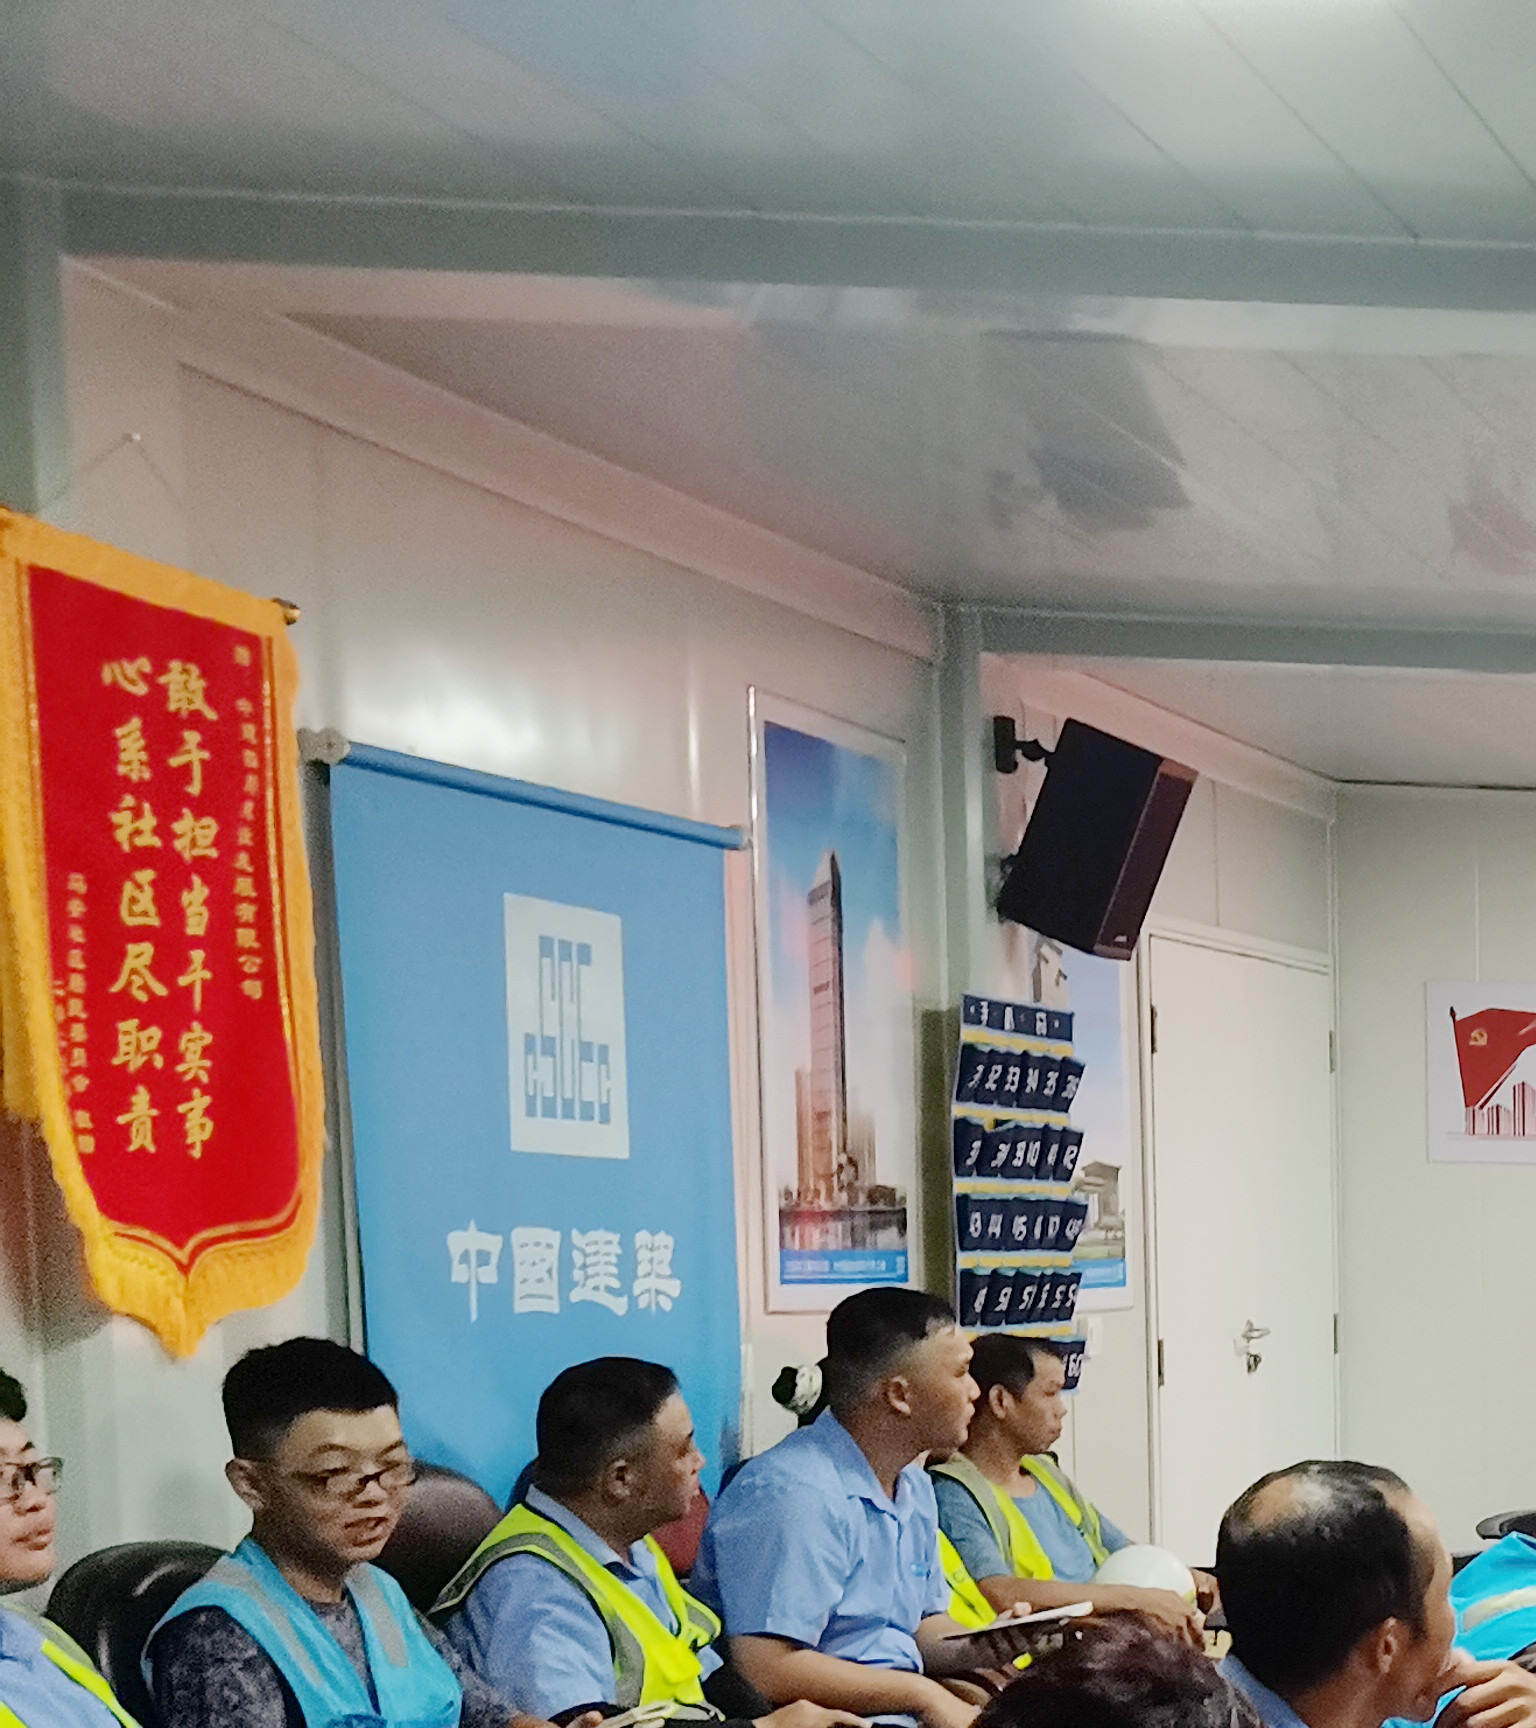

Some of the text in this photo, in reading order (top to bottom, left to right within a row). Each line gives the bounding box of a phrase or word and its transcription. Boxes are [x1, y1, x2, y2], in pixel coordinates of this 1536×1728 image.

[101, 656, 168, 1154] 心系社区尽职责
[157, 659, 218, 1161] 敢于担当干实事
